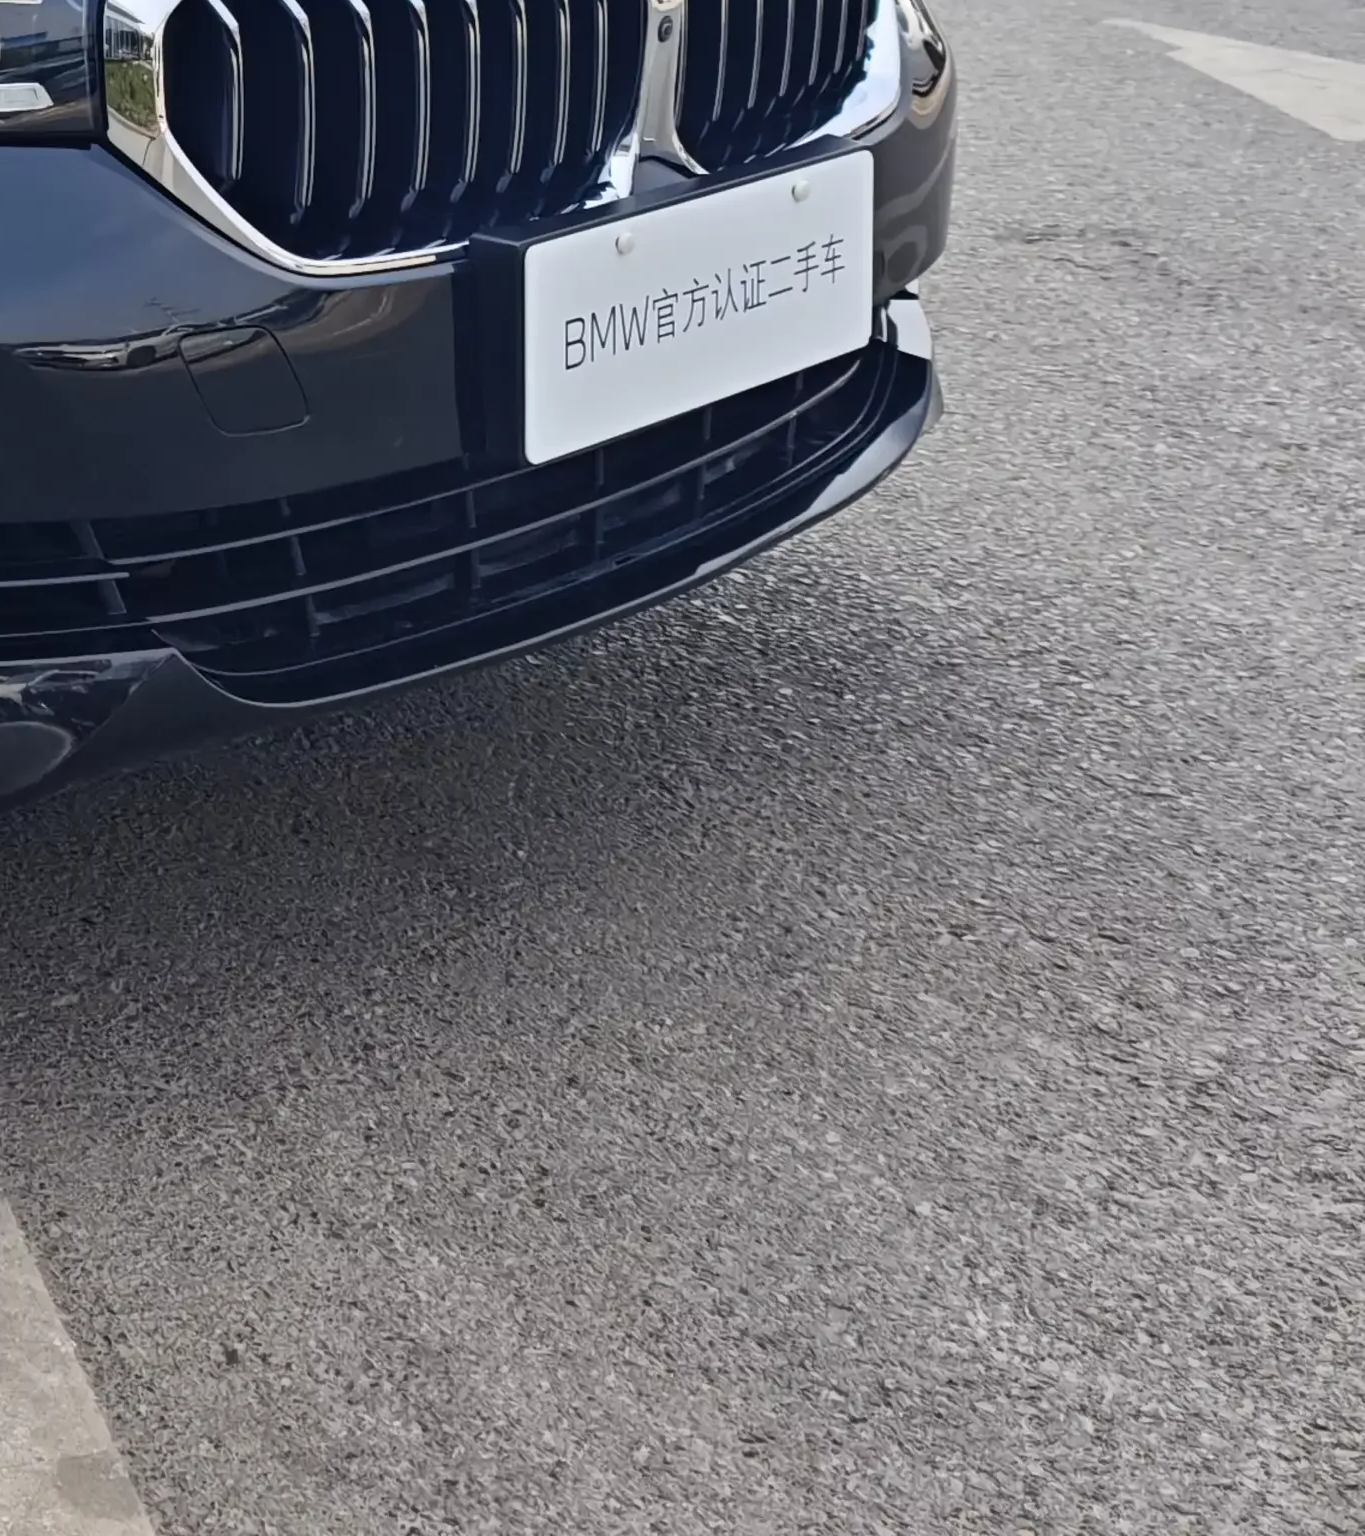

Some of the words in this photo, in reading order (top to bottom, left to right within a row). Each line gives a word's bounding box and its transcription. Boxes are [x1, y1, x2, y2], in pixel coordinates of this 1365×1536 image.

[564, 234, 846, 371] BMW官方认证二手车
